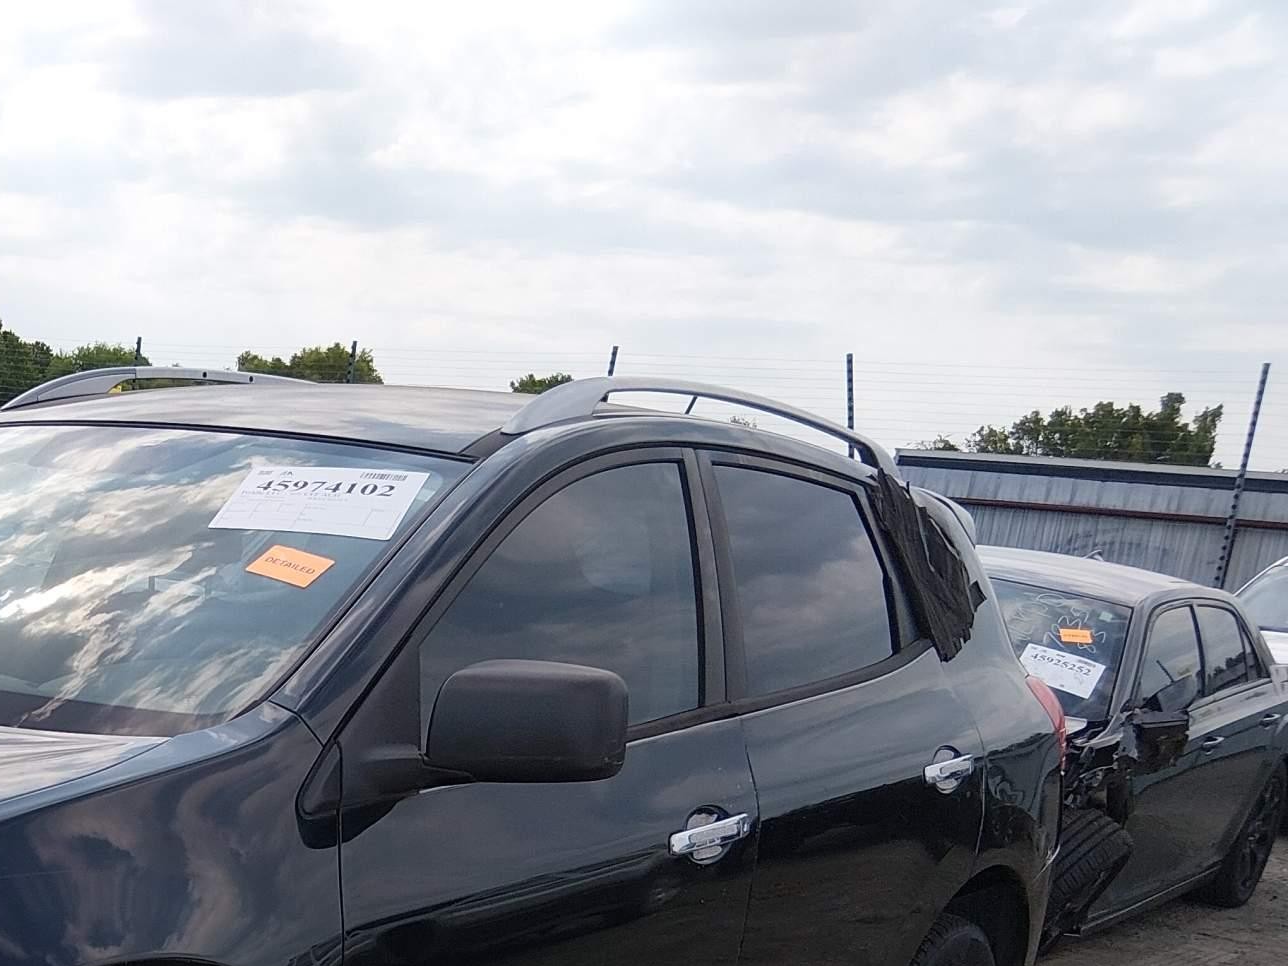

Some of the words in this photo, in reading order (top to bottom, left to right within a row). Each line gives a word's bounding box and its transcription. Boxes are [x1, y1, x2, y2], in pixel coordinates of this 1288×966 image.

[257, 480, 396, 497] 45974102
[265, 556, 315, 575] DETAILED
[1031, 653, 1092, 676] 45925252
